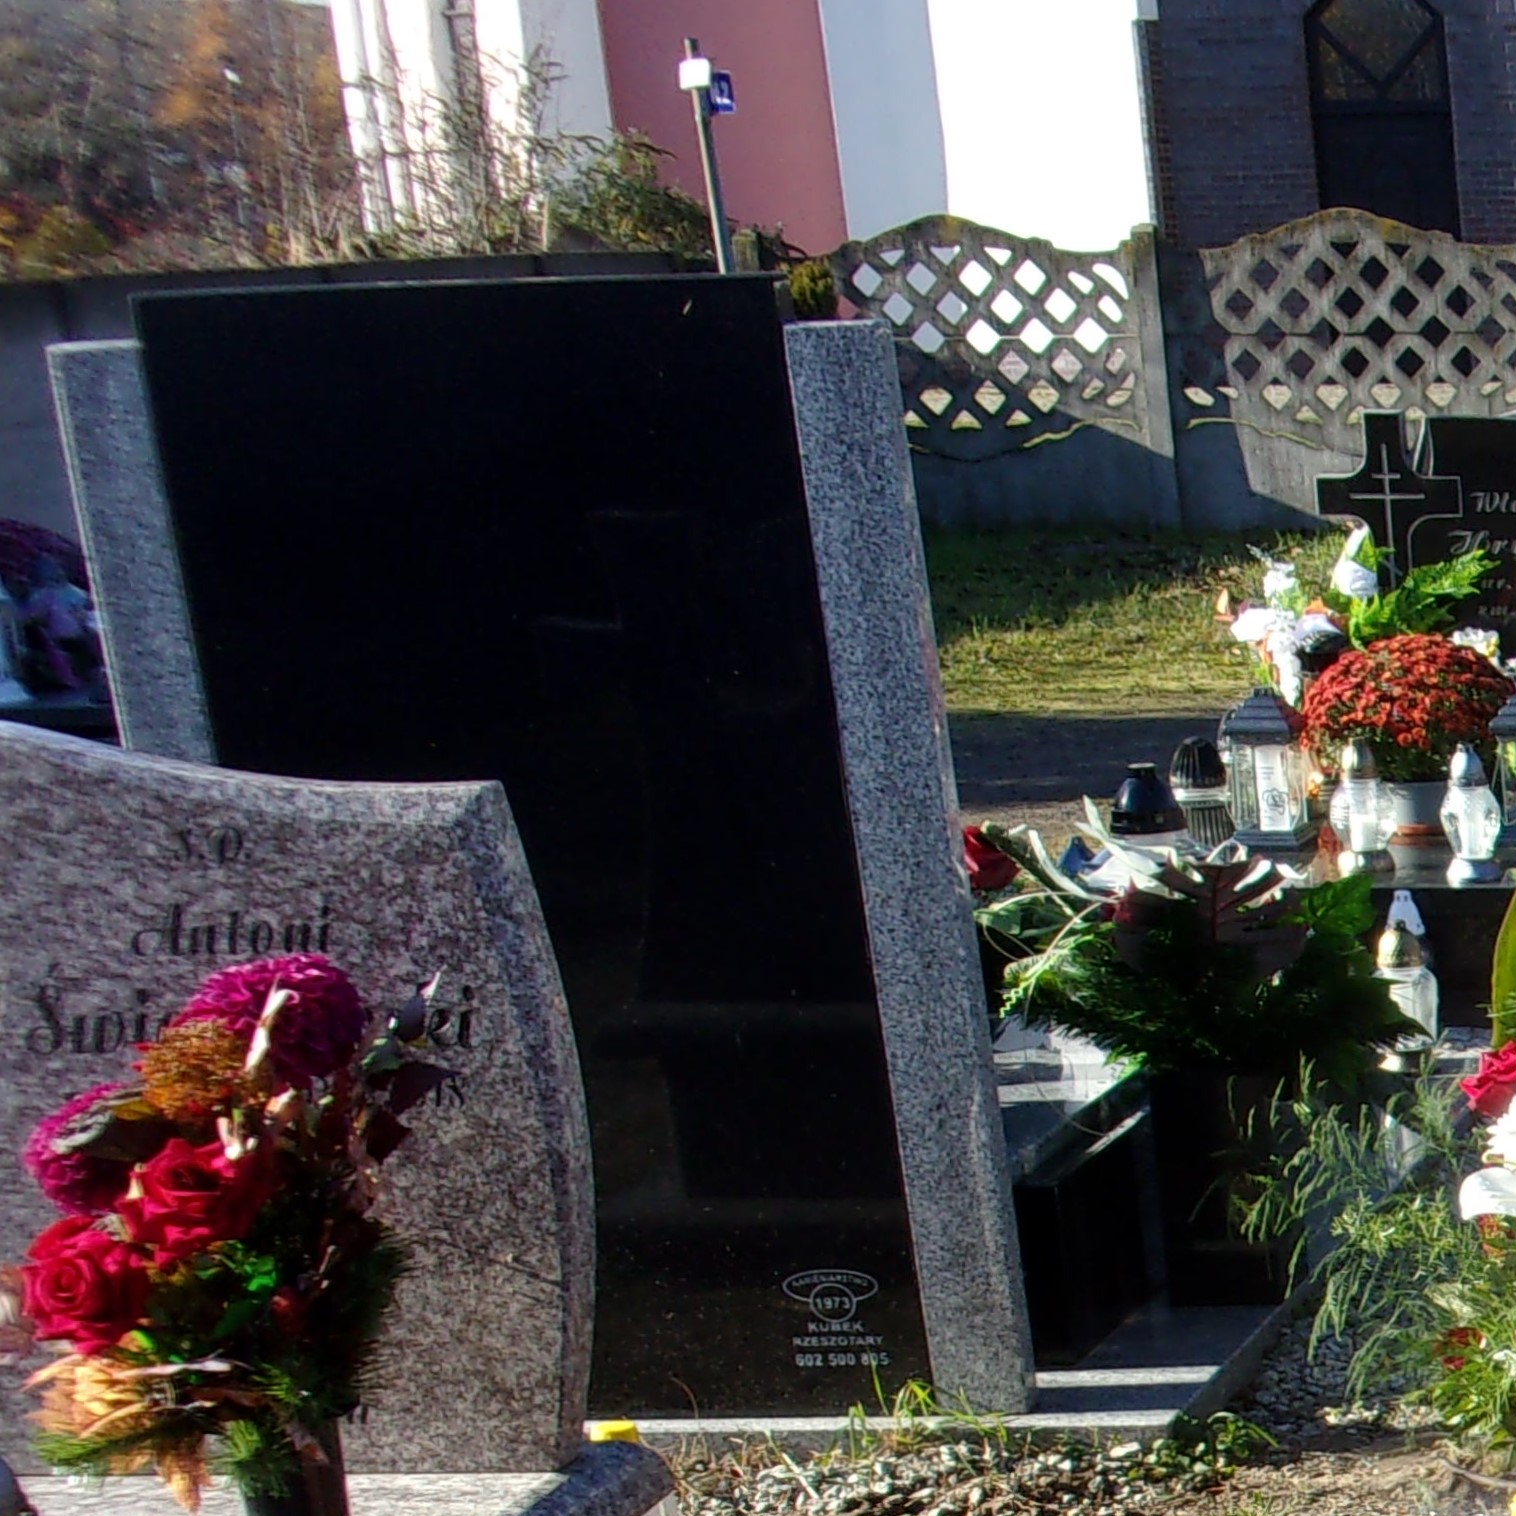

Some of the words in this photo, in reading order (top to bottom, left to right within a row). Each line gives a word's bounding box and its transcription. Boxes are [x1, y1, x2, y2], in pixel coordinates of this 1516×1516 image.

[131, 897, 334, 958] Antoni
[815, 1296, 850, 1310] 1973
[807, 1321, 864, 1333] KUBEK
[792, 1336, 884, 1347] RZESZOTARY
[795, 1353, 823, 1367] 602
[828, 1353, 856, 1366] 500
